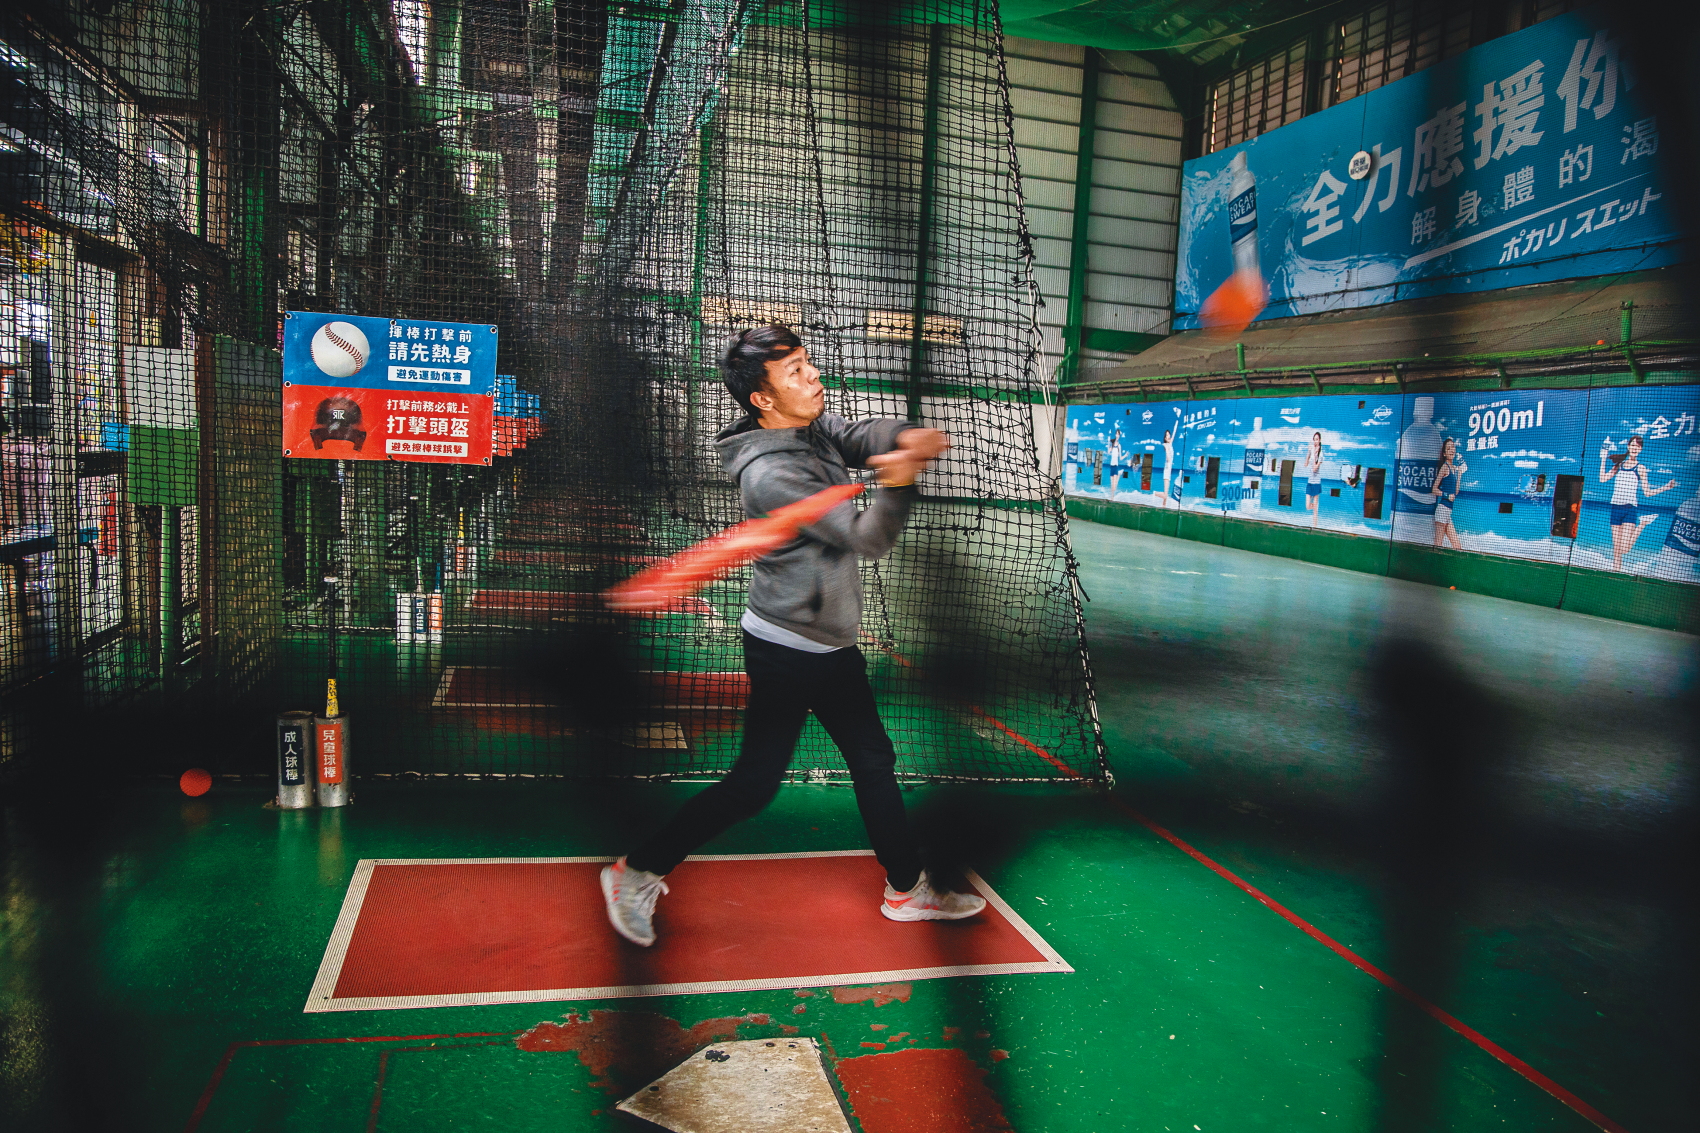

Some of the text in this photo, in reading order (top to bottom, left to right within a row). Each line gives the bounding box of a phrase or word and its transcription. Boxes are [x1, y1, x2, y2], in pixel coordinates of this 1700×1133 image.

[1301, 29, 1637, 246] 全力應援你
[1411, 115, 1658, 245] 解身體的渴
[1230, 192, 1256, 212] POCARI
[1230, 200, 1254, 222] SWEAT
[388, 325, 472, 343] 揮棒打擊前
[388, 341, 472, 364] 請先熱身
[396, 368, 463, 382] 避免運動傷害
[387, 399, 470, 414] 打擊前務必戴上
[386, 415, 470, 438] 打擊頭盔
[1468, 401, 1544, 437] 900ml
[1649, 411, 1700, 440] 全力
[391, 442, 463, 454] 避免擦棒球誤擊
[1466, 436, 1499, 451] 重量瓶
[1397, 475, 1435, 488] SWEAT
[284, 731, 298, 781] 成人球棒
[323, 729, 336, 778] 兒童球棒
